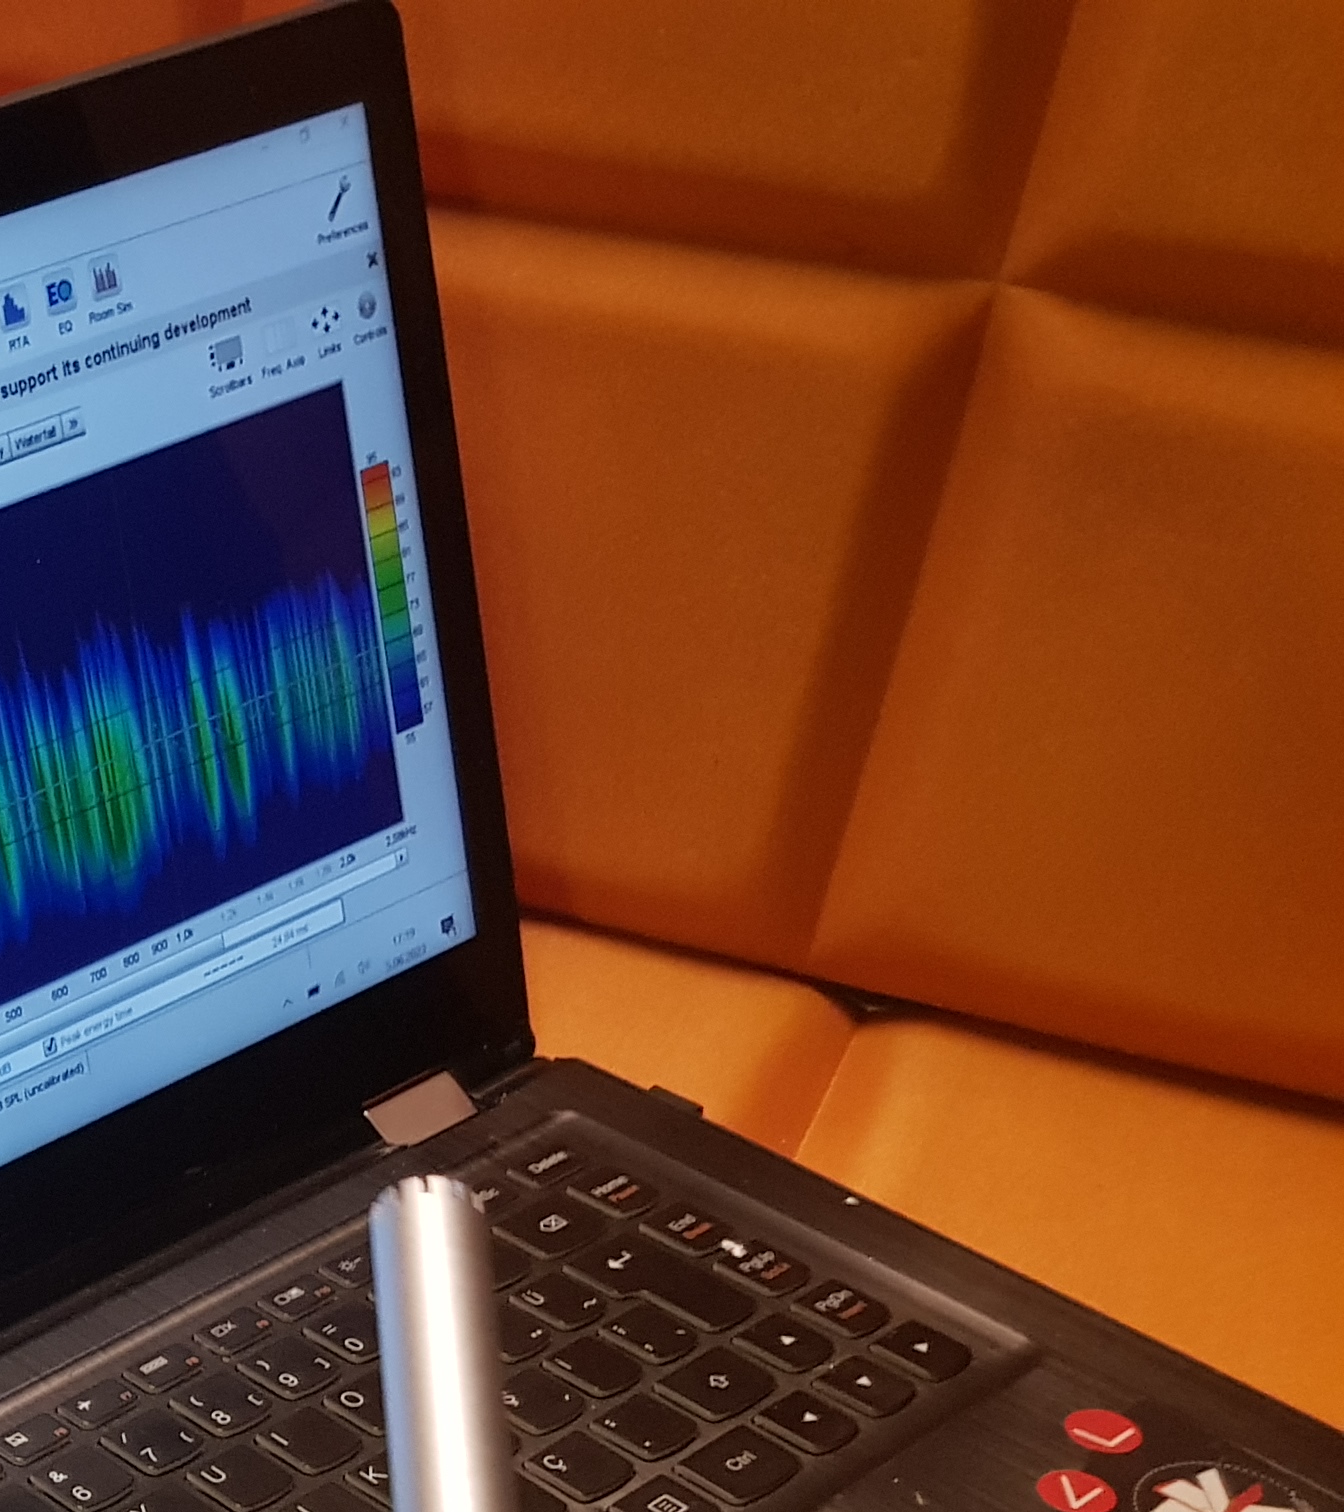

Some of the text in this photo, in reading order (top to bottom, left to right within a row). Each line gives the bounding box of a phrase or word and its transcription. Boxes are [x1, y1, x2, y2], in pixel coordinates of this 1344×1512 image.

[58, 319, 74, 336] EQ
[0, 365, 59, 404] support
[61, 356, 81, 379] its
[83, 327, 161, 373] continuing
[162, 295, 252, 345] development
[7, 334, 30, 353] RTA
[4, 1006, 23, 1024] 500
[725, 1450, 758, 1472] Ctrl
